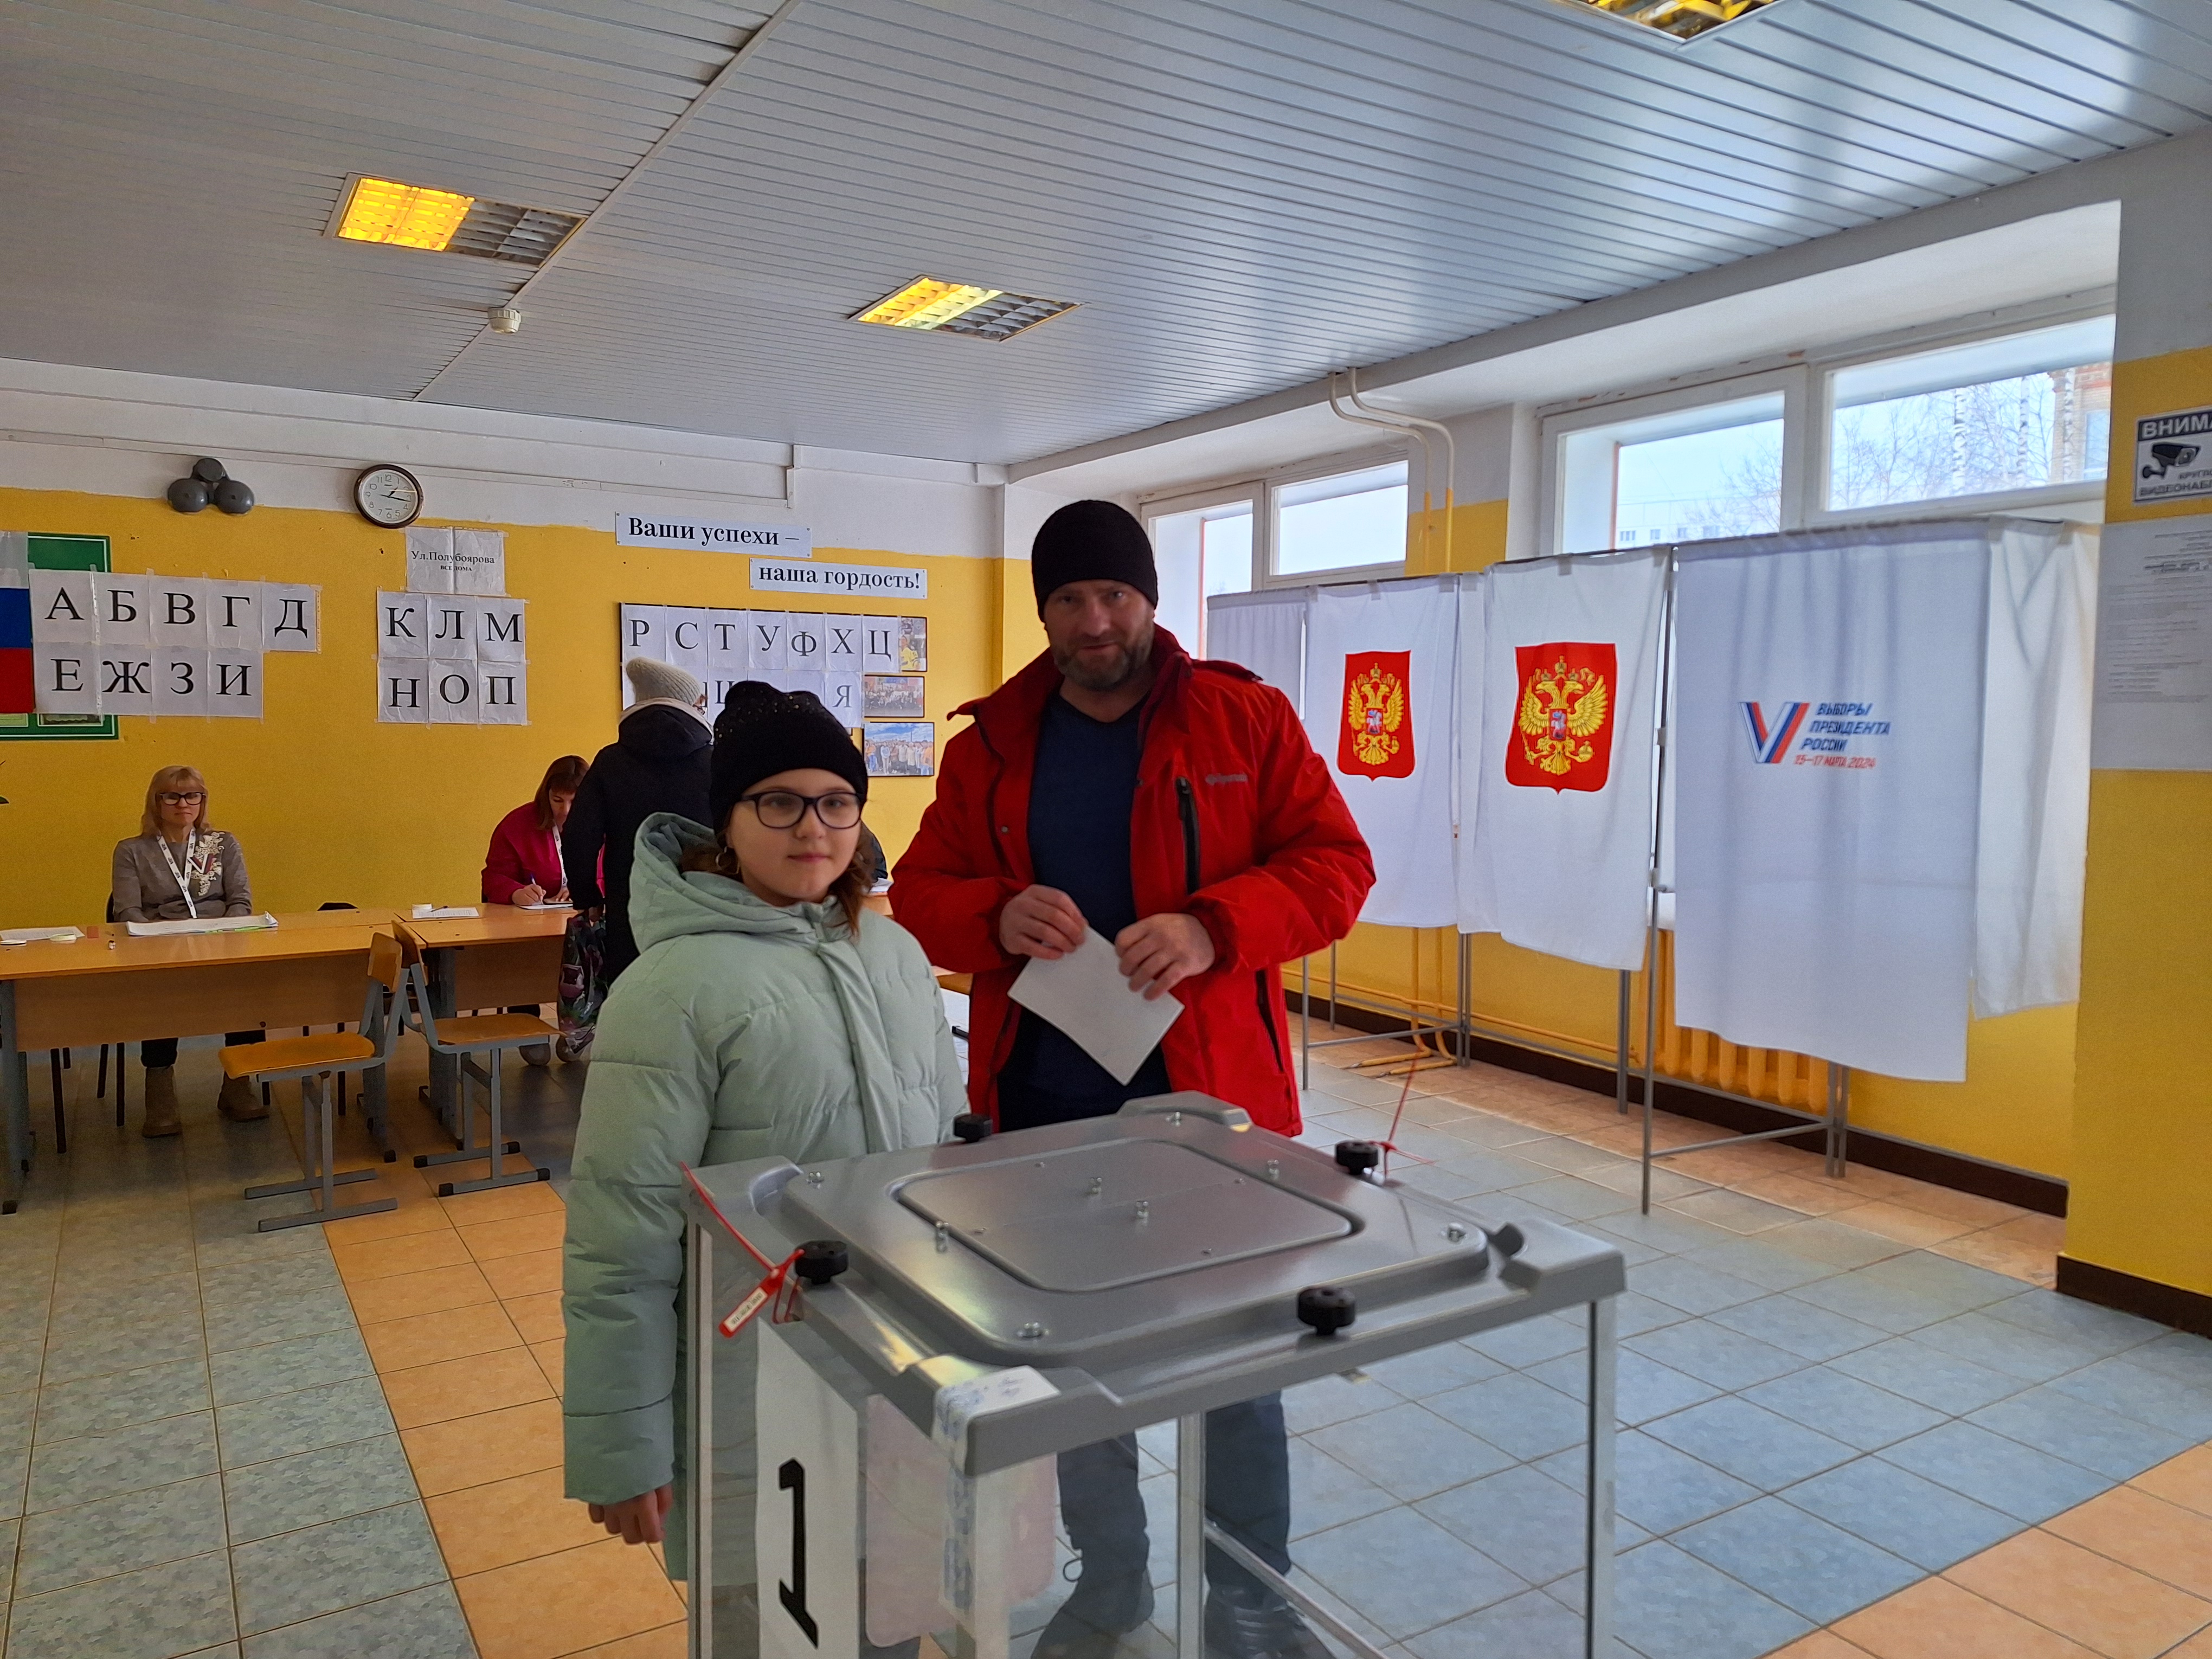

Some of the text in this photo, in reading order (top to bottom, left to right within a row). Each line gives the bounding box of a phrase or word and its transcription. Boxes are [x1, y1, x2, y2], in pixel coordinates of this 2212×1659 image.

[2142, 413, 2212, 439] ВНИМ
[628, 517, 695, 539] Ваши
[701, 526, 779, 546] успехи
[410, 550, 495, 565] Ул.Полубоярова
[758, 567, 921, 590] наша гордость!
[44, 587, 307, 638] А Б В Г Д
[385, 607, 522, 642] К Л М
[629, 620, 892, 661] Р С Т У Ф Х Ц
[50, 659, 252, 696] Е Ж З И
[388, 674, 517, 708] Н О П
[833, 685, 851, 708] Я
[1816, 703, 1873, 716] ВЫБОРЫ
[1810, 721, 1891, 736] ПРЕЗИДЕНТА
[1799, 738, 1848, 751] РОССИИ
[779, 1457, 819, 1650] 1
